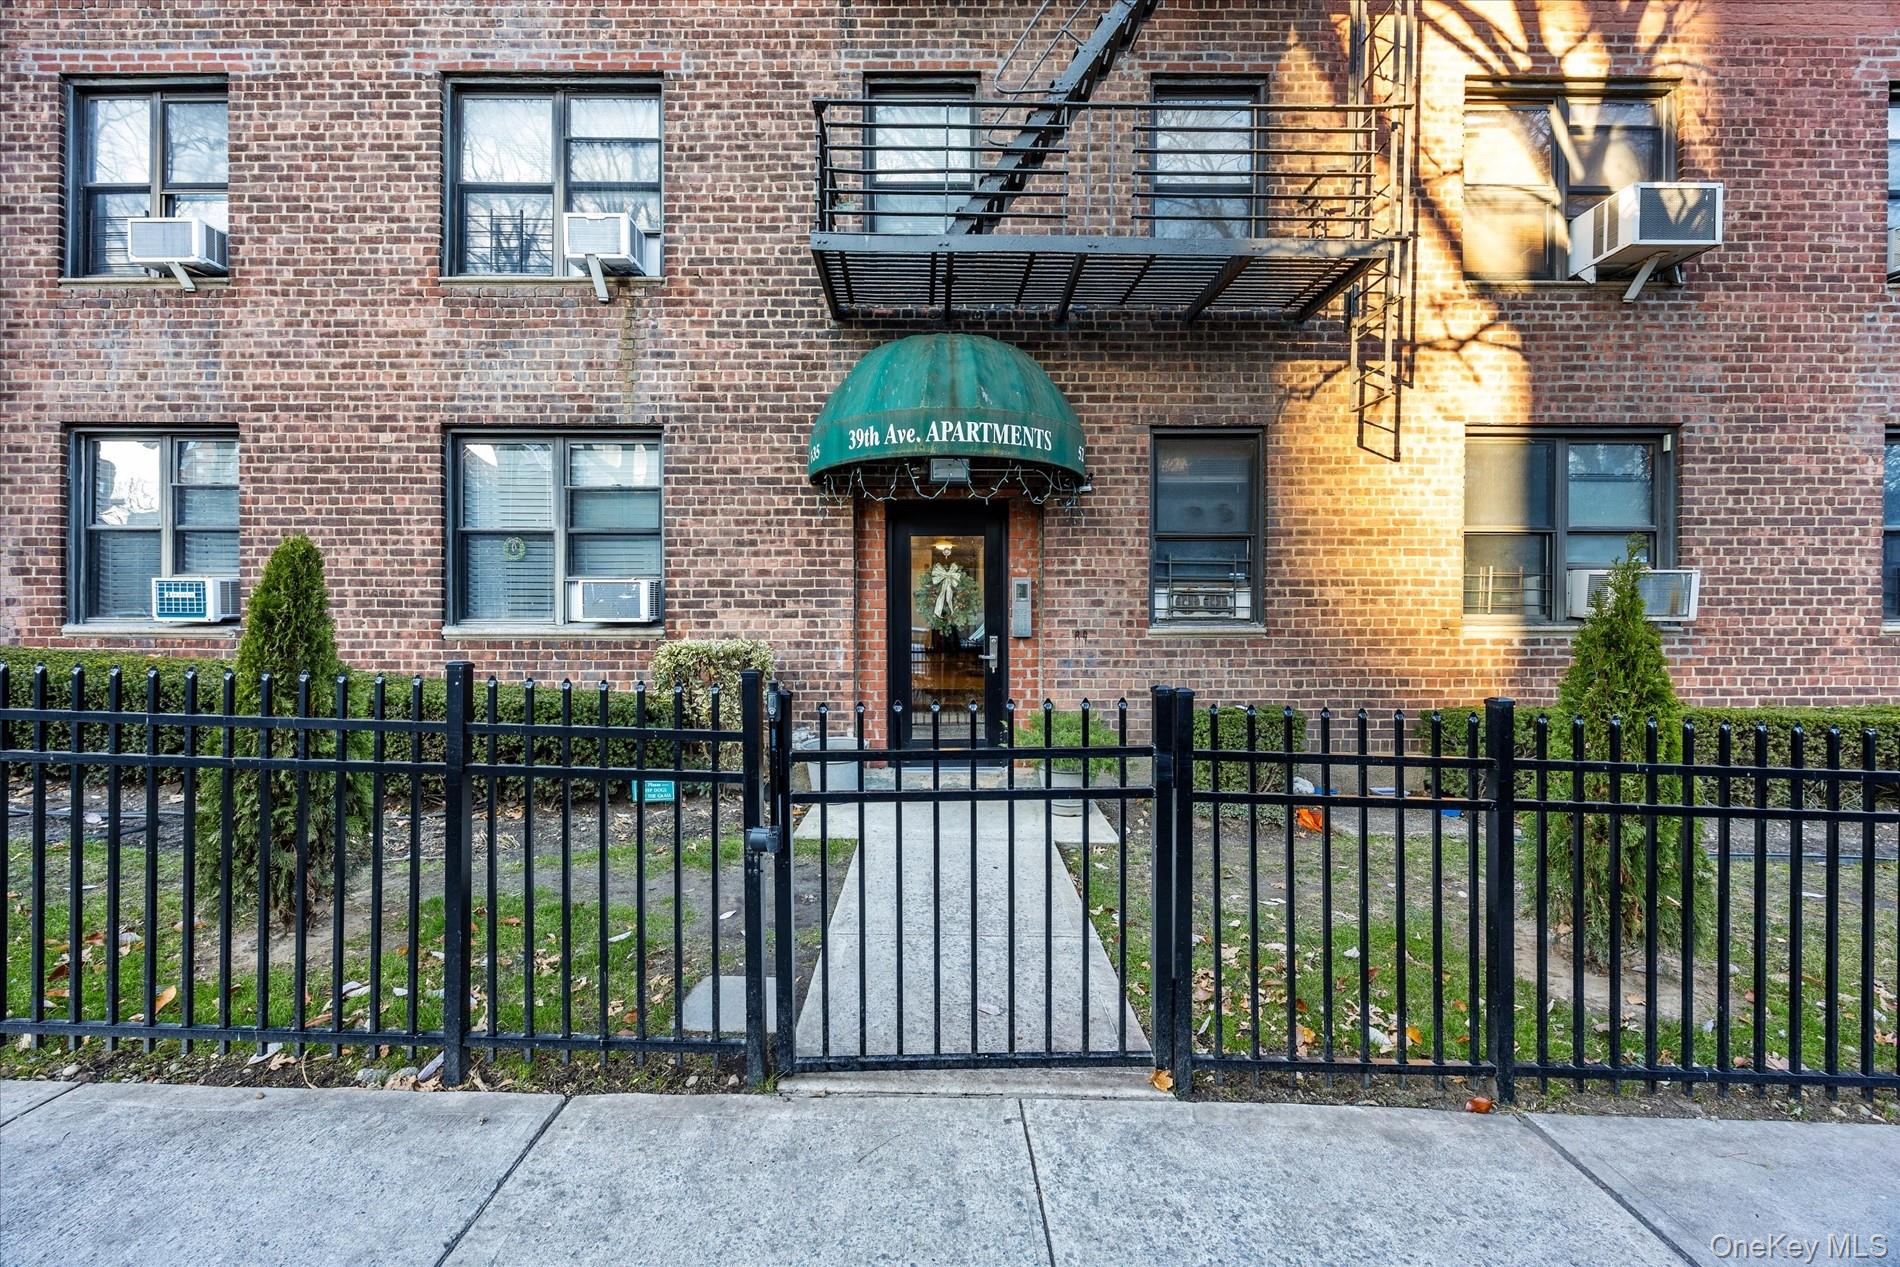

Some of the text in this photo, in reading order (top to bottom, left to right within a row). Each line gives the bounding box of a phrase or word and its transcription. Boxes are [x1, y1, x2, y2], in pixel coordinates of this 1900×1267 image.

[848, 420, 1052, 451] 39th Ave. APARTMENTS
